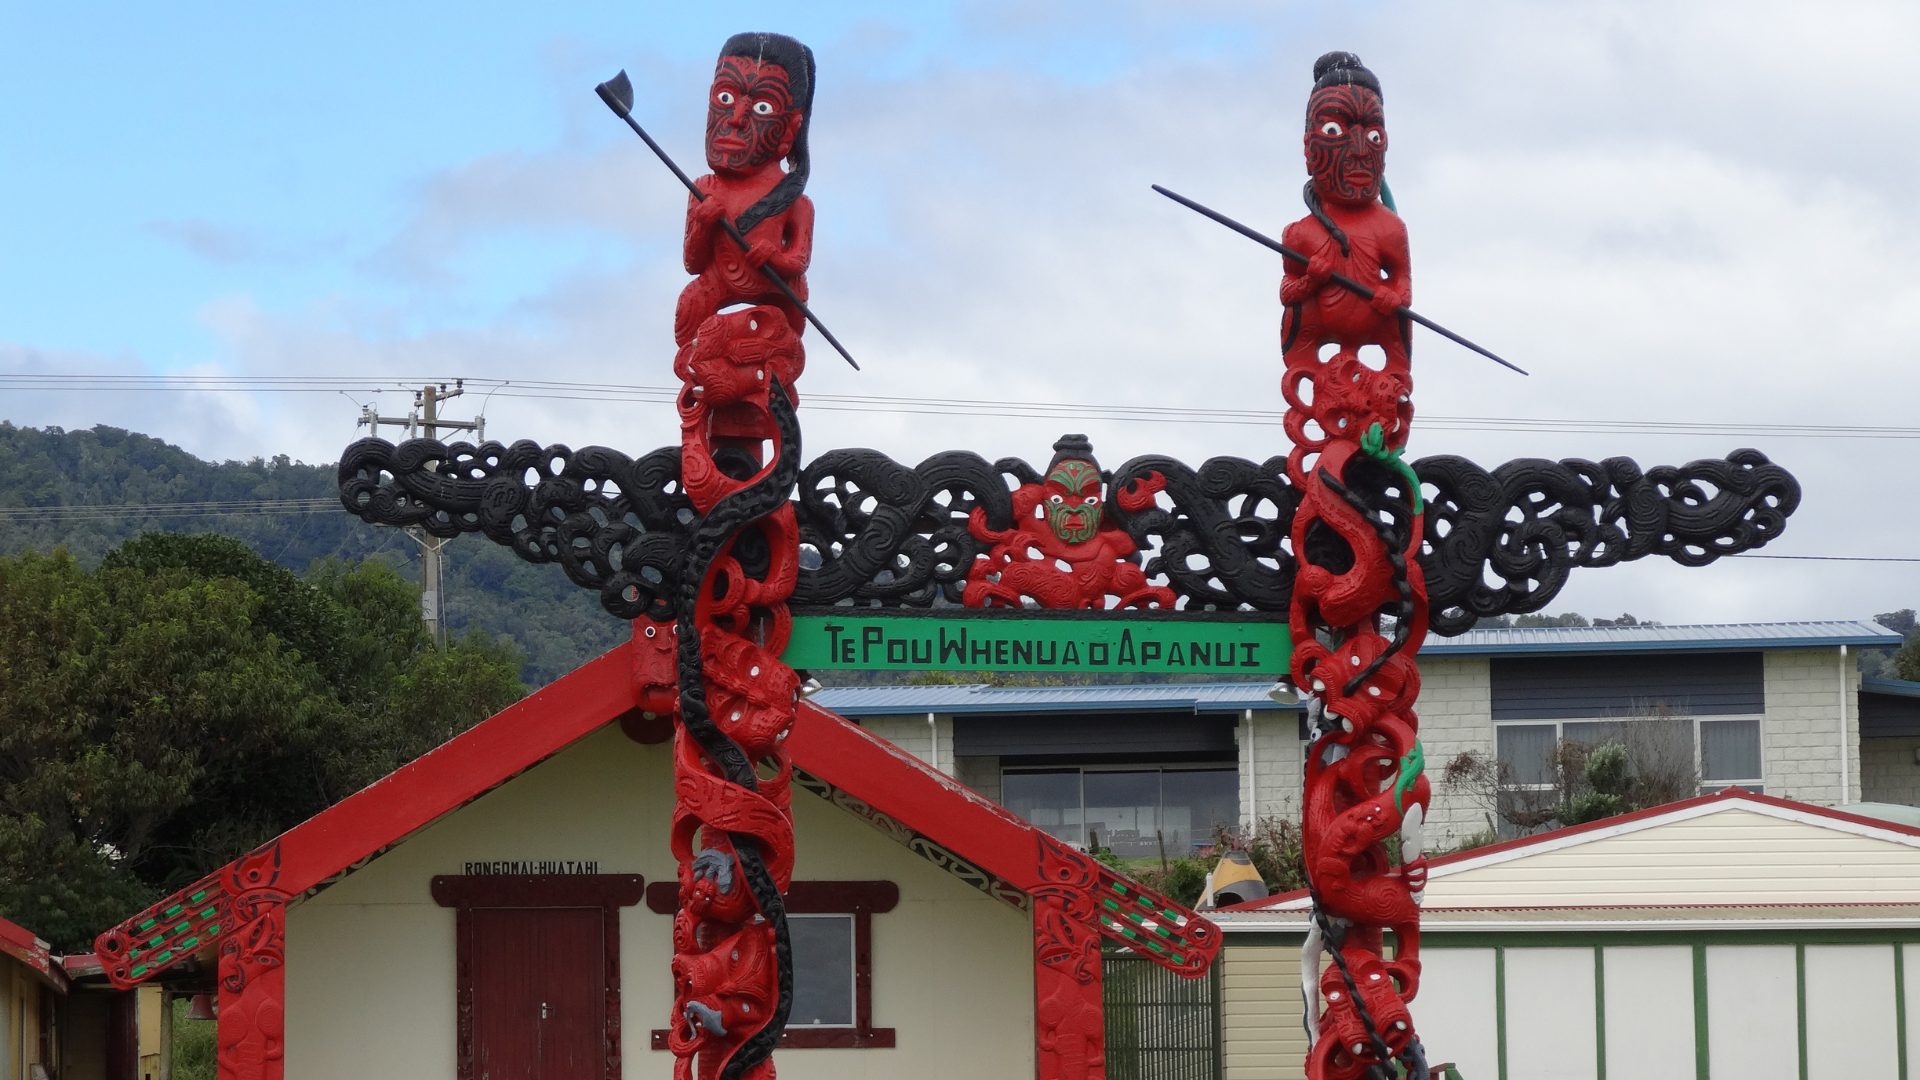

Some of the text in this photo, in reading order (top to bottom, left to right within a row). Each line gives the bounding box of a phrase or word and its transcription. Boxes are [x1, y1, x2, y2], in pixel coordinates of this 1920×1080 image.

[824, 626, 856, 663] TE
[862, 626, 932, 664] POU
[939, 626, 1081, 666] WHENUA
[1117, 628, 1261, 667] APANUI
